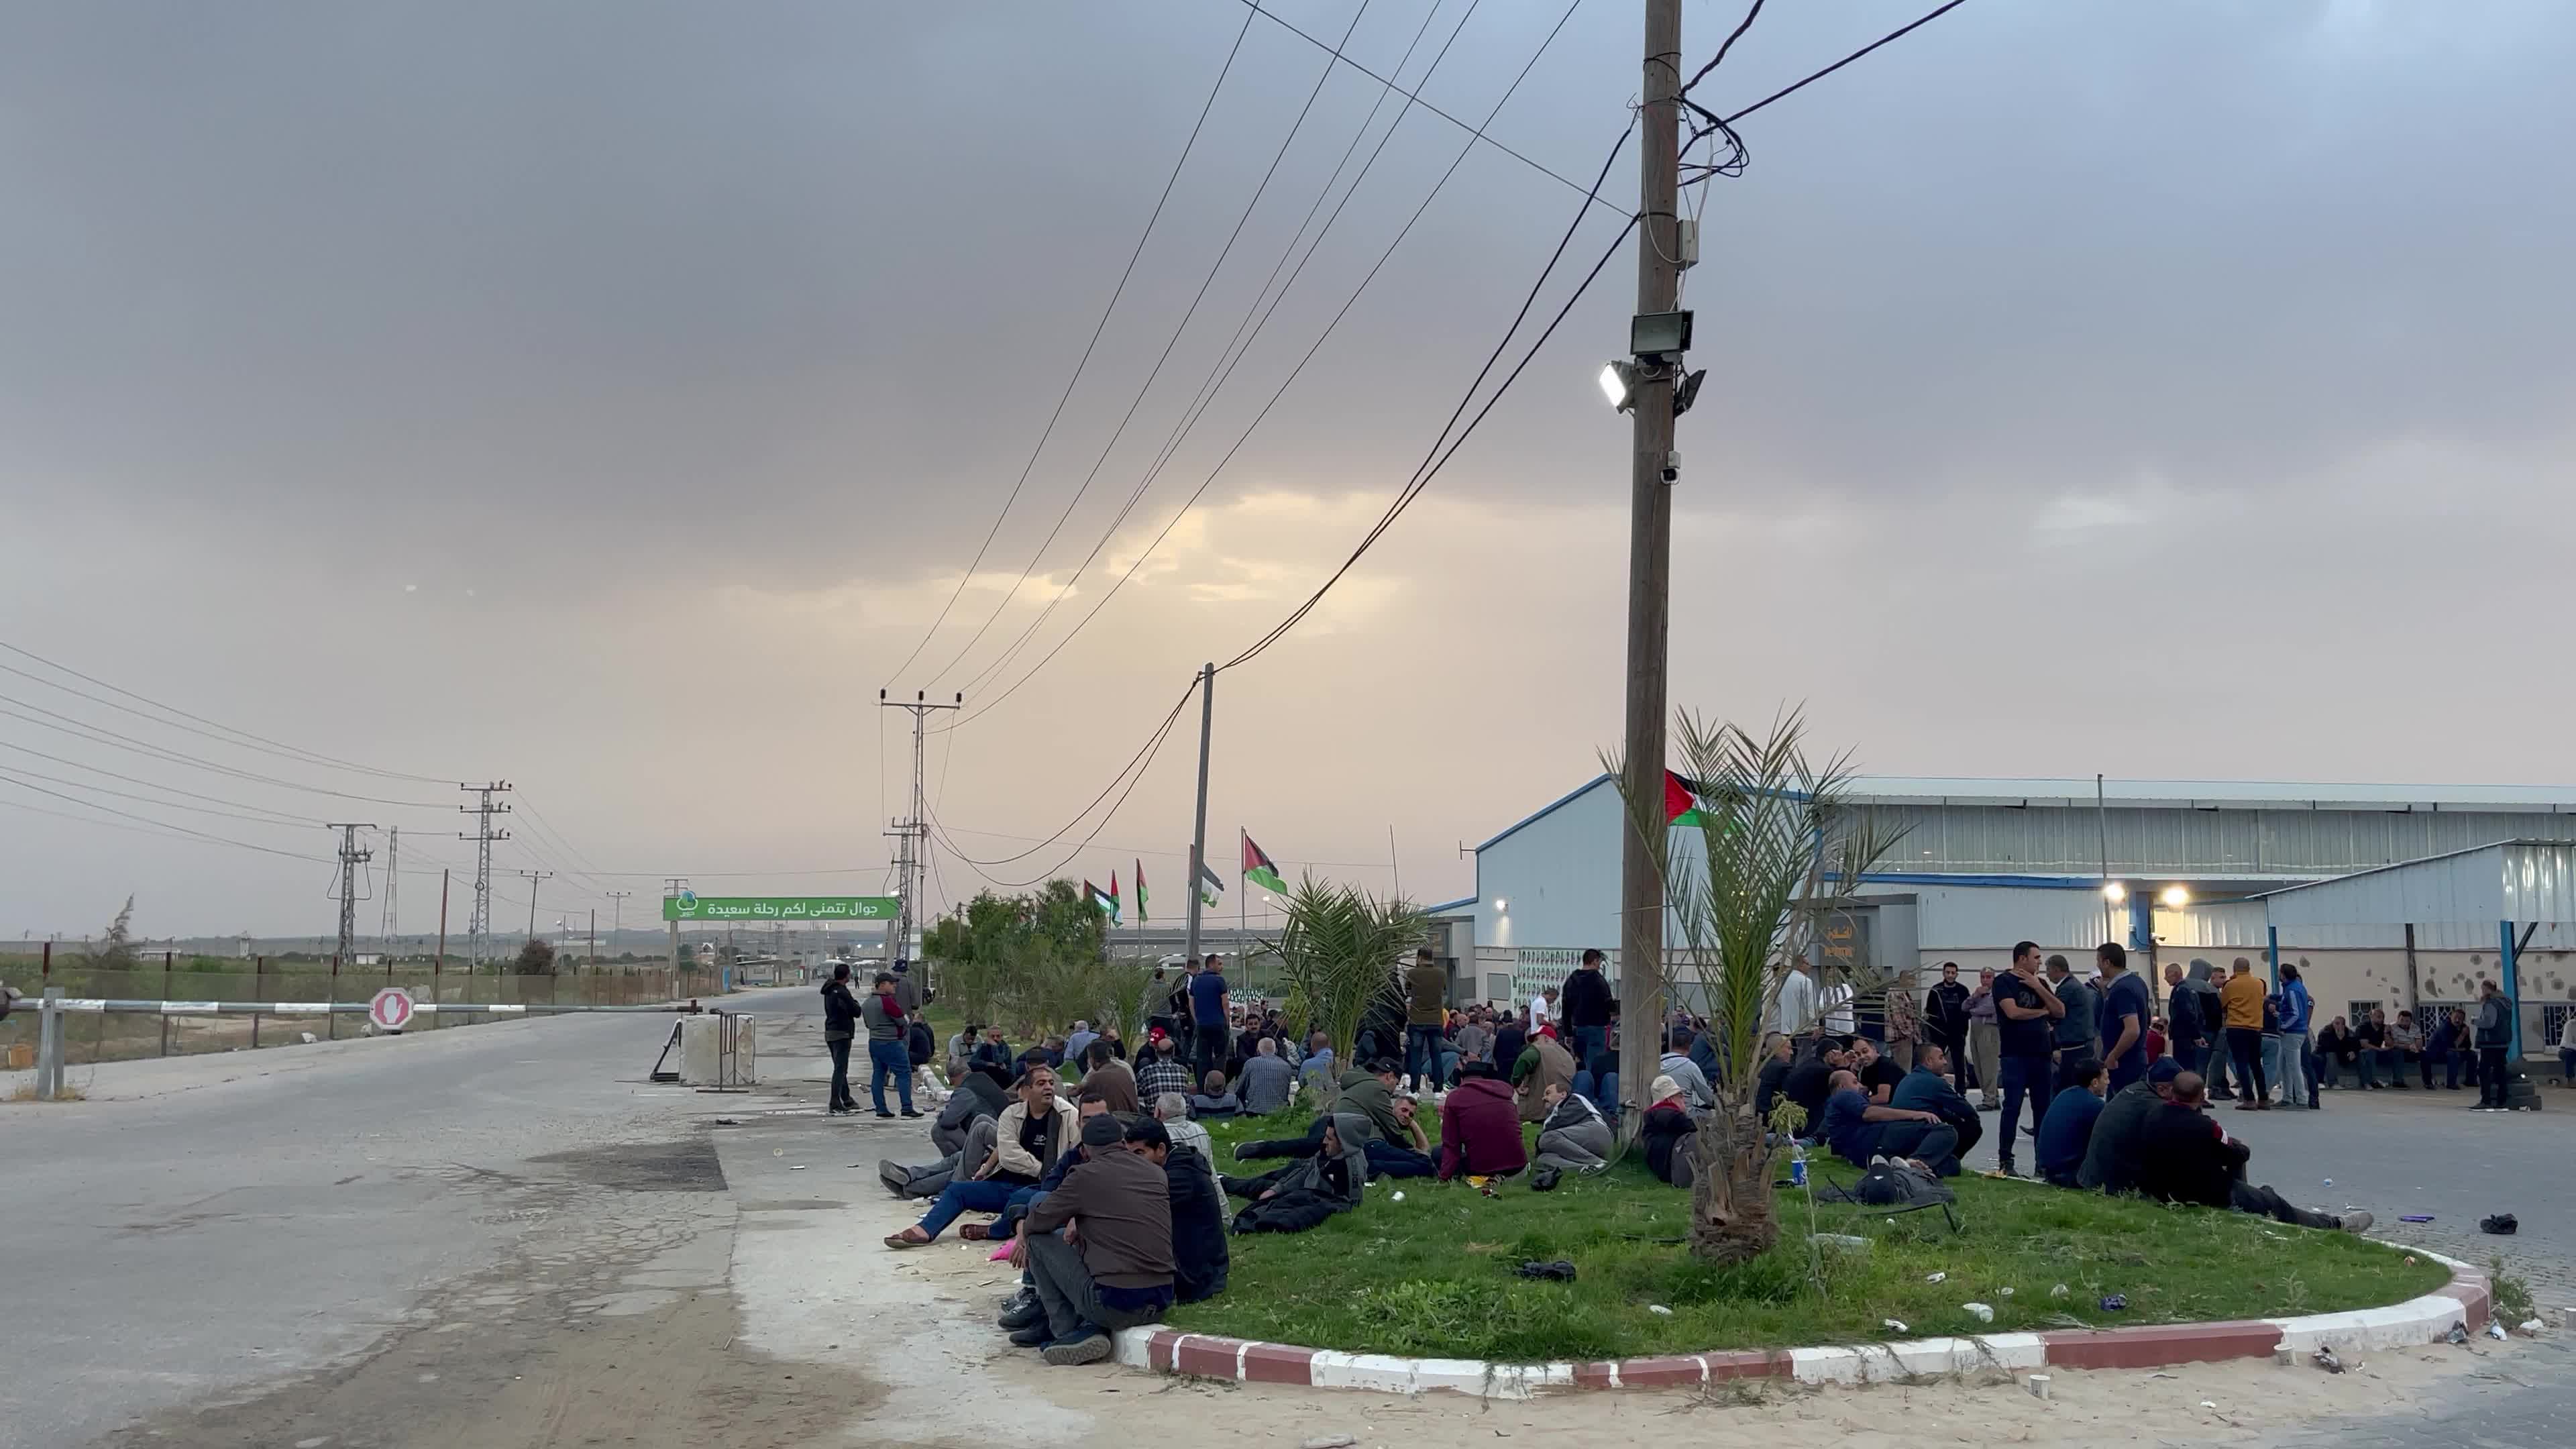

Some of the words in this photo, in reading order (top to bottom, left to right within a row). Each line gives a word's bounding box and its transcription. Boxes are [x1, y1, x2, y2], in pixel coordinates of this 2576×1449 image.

[707, 903, 751, 918] سعيدة
[753, 902, 780, 917] رحلة
[782, 902, 806, 918] لكم
[810, 902, 847, 917] تتمنى
[849, 902, 878, 916] جوال
